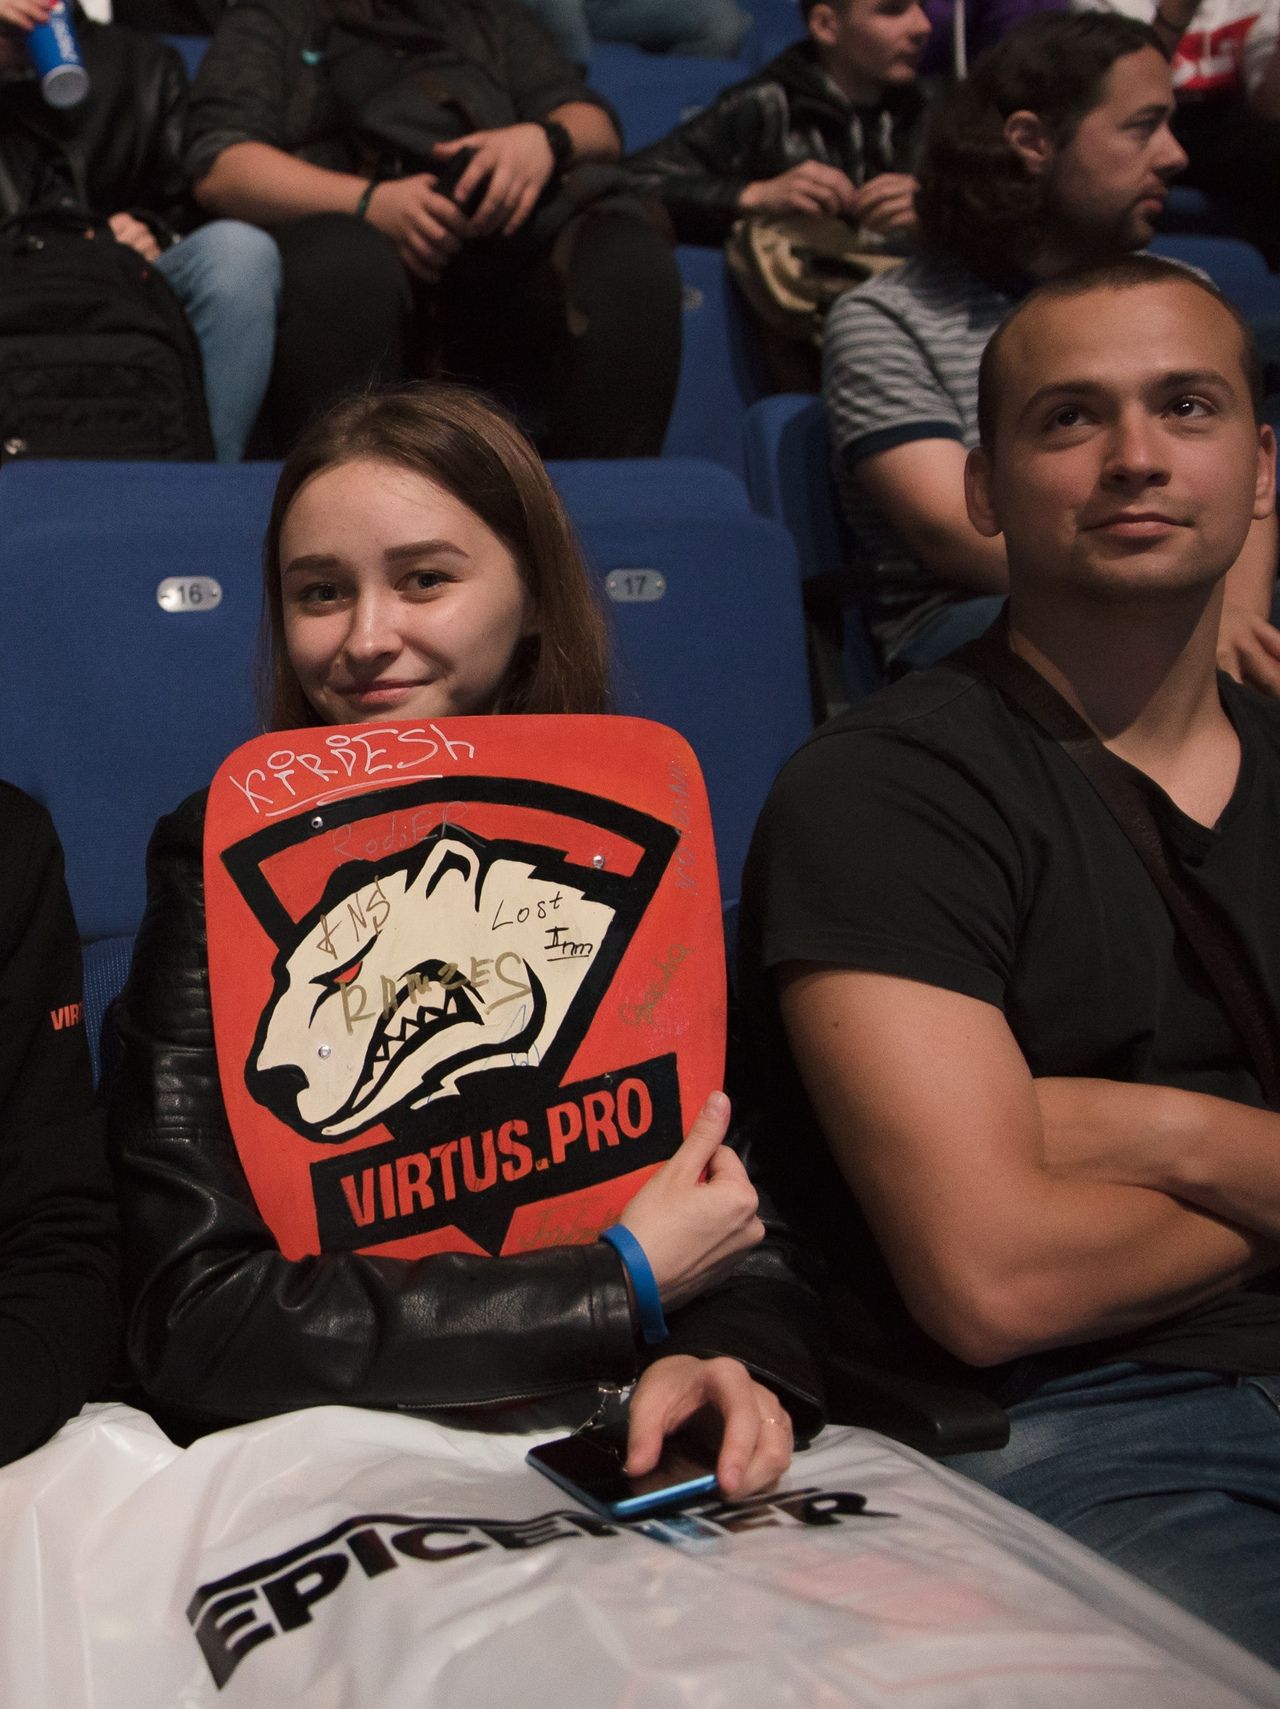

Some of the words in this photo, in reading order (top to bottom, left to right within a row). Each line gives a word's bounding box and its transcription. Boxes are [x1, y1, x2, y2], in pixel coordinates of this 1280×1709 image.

[178, 582, 202, 605] 16
[624, 575, 647, 596] 17
[492, 891, 563, 931] Lost
[340, 1078, 653, 1228] VIRTUS.PRO
